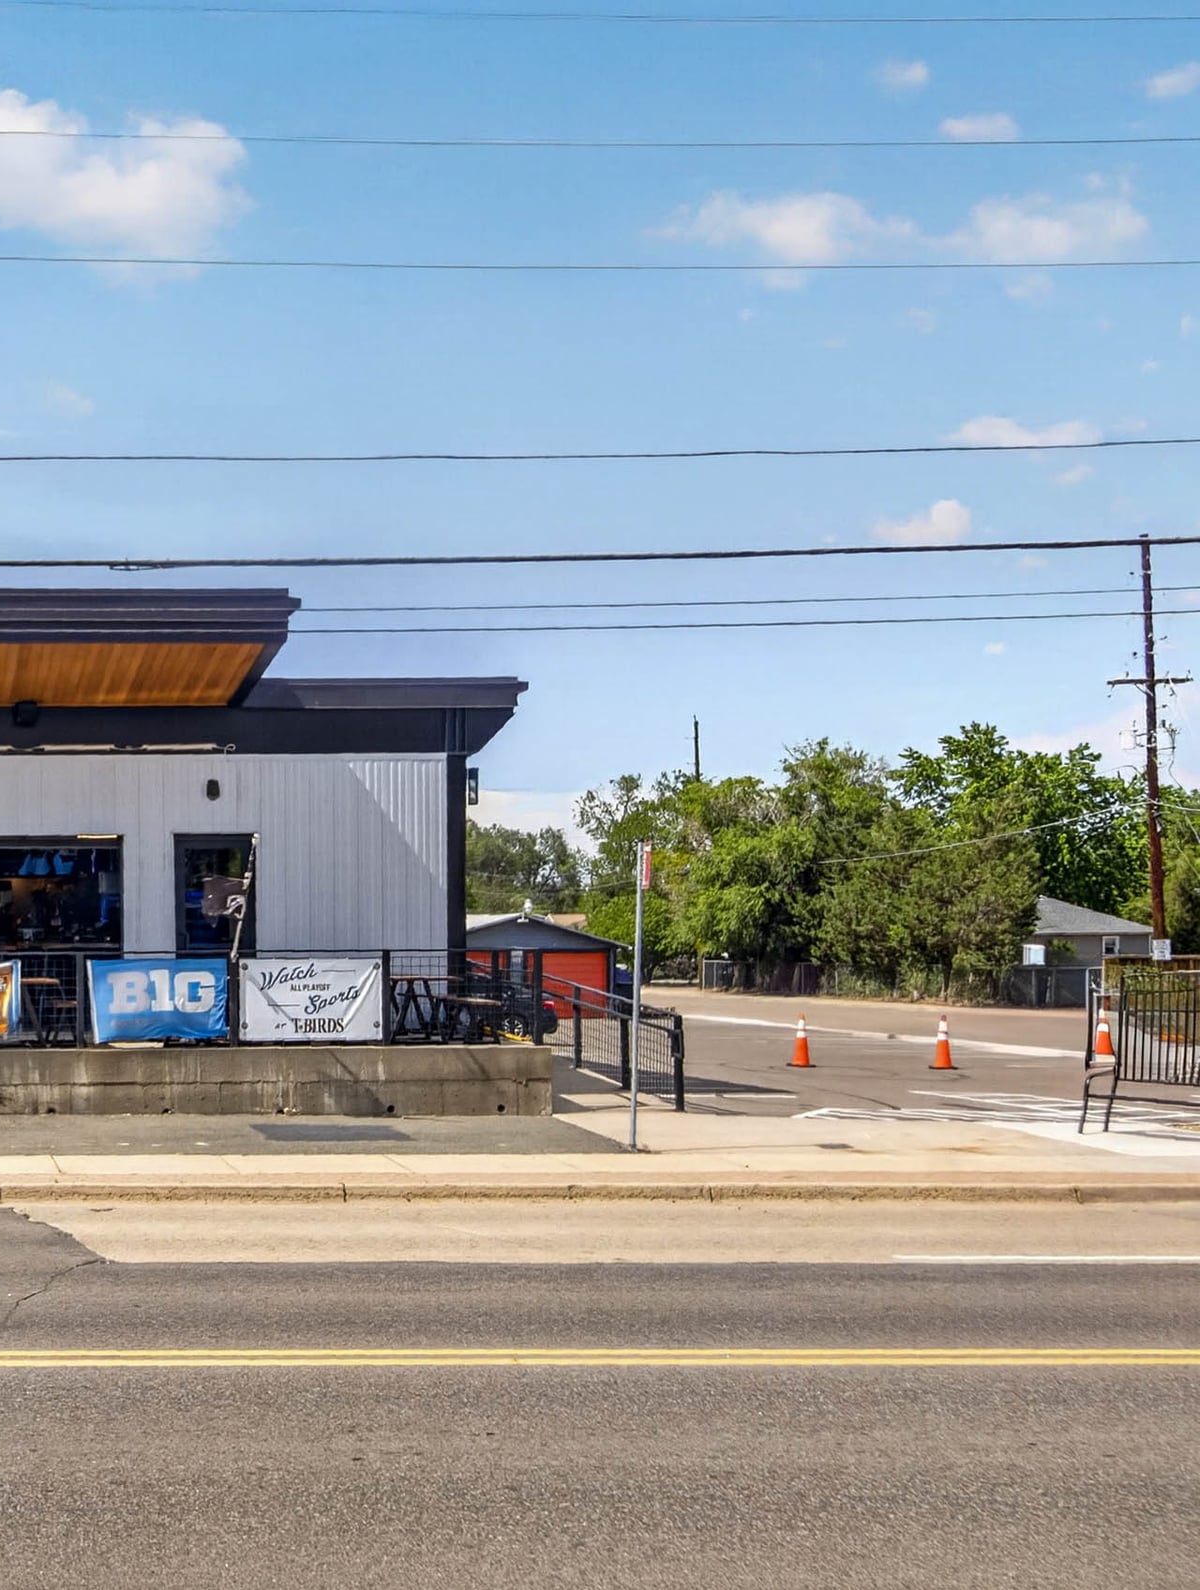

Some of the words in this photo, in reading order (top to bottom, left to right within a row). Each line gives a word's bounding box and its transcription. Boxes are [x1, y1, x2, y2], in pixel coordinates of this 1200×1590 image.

[260, 962, 318, 991] Watch
[290, 984, 302, 992] ALL
[303, 984, 331, 992] PLAYOFF
[304, 985, 361, 1015] Sports
